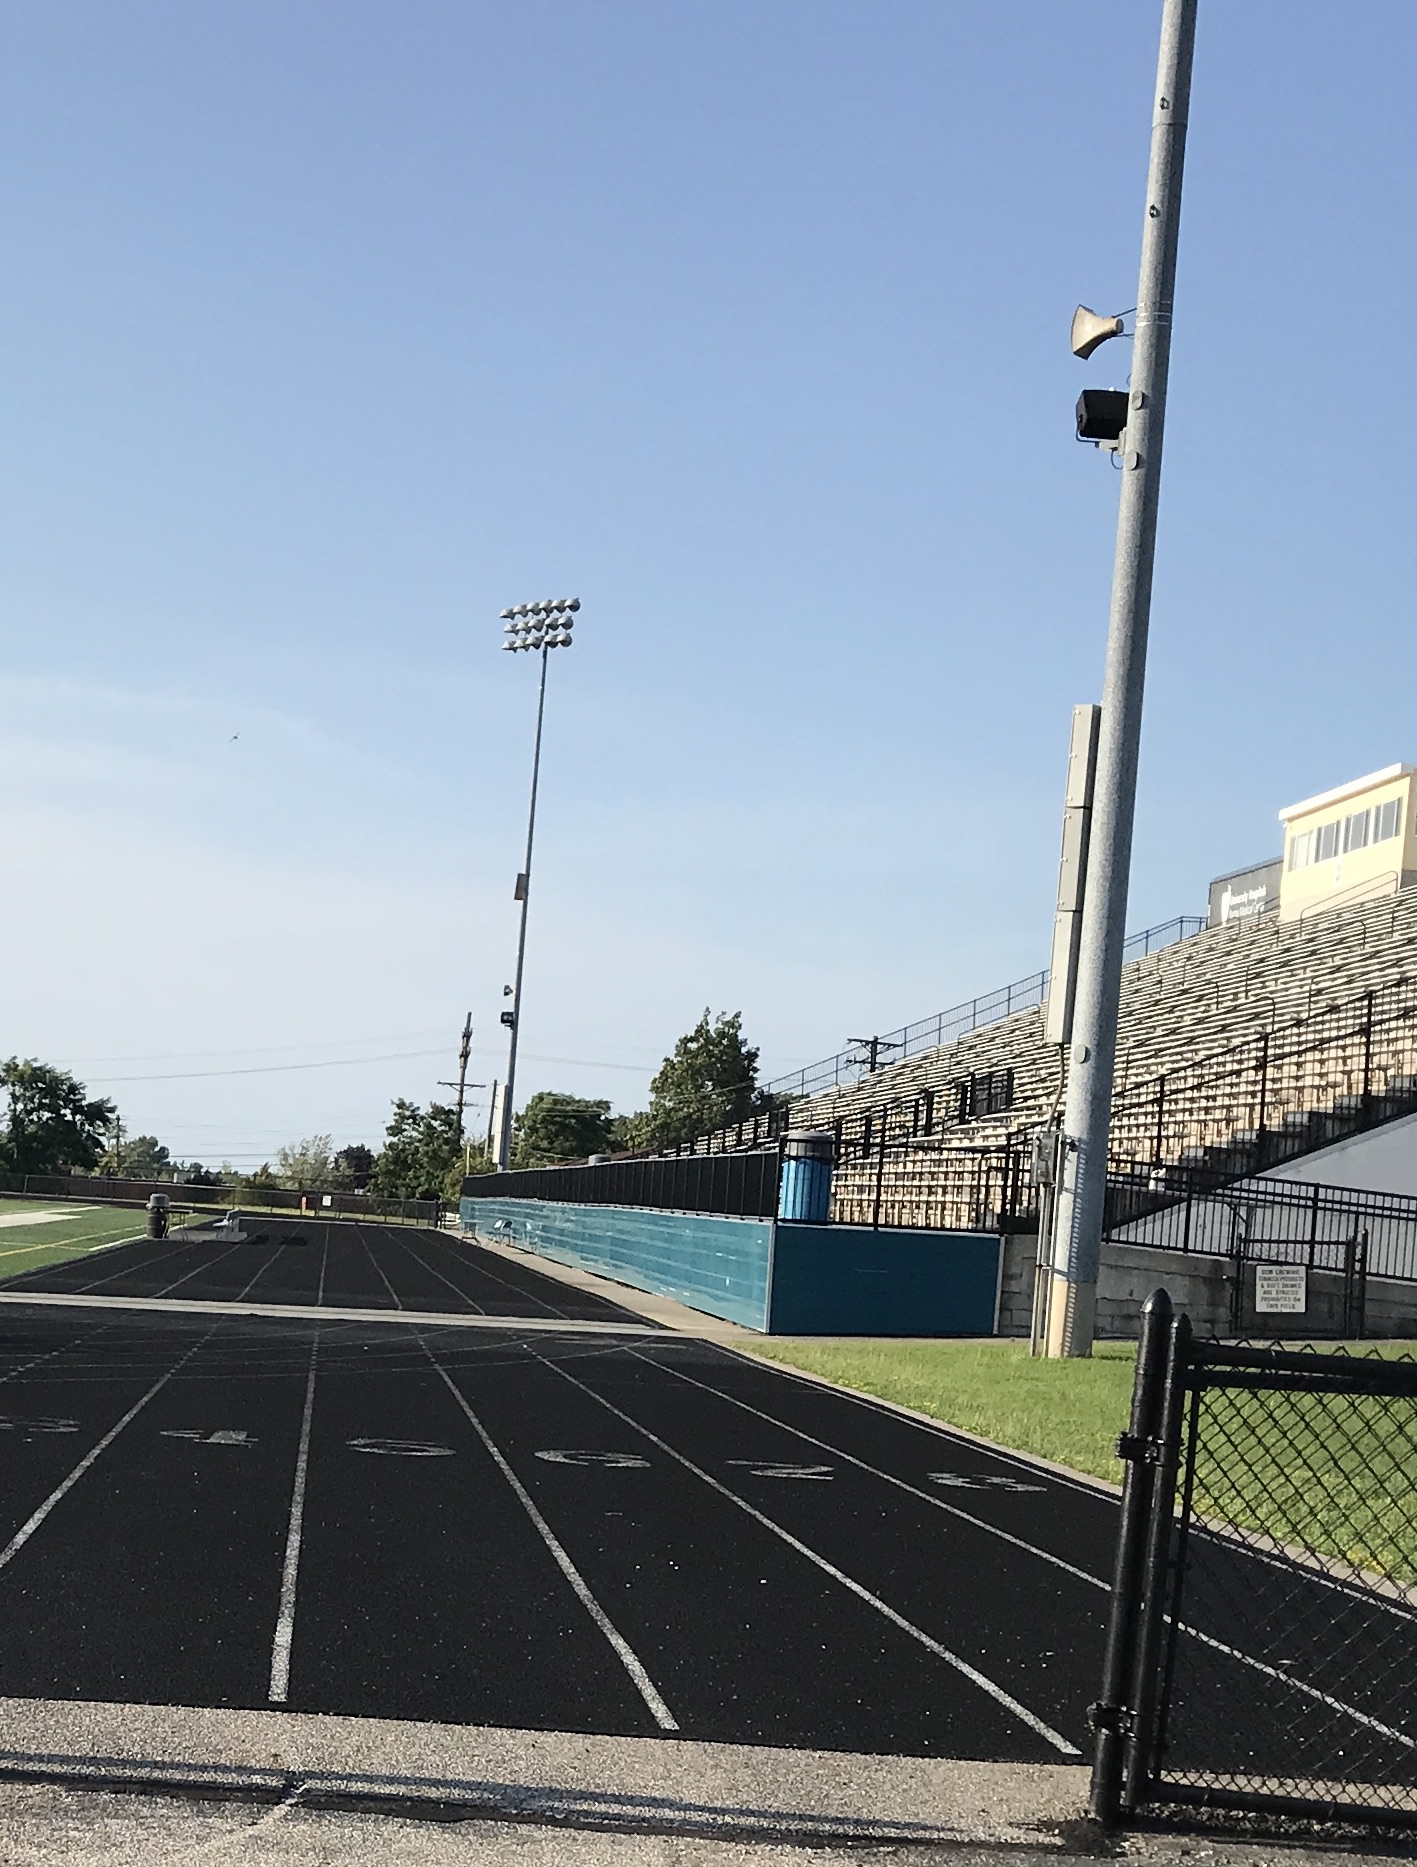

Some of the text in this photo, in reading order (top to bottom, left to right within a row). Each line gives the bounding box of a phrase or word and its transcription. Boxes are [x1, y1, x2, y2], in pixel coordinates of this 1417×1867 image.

[160, 1430, 258, 1448] 4
[346, 1438, 456, 1455] 5
[534, 1450, 650, 1467] 6
[726, 1461, 834, 1480] 7
[926, 1472, 1048, 1491] 8
